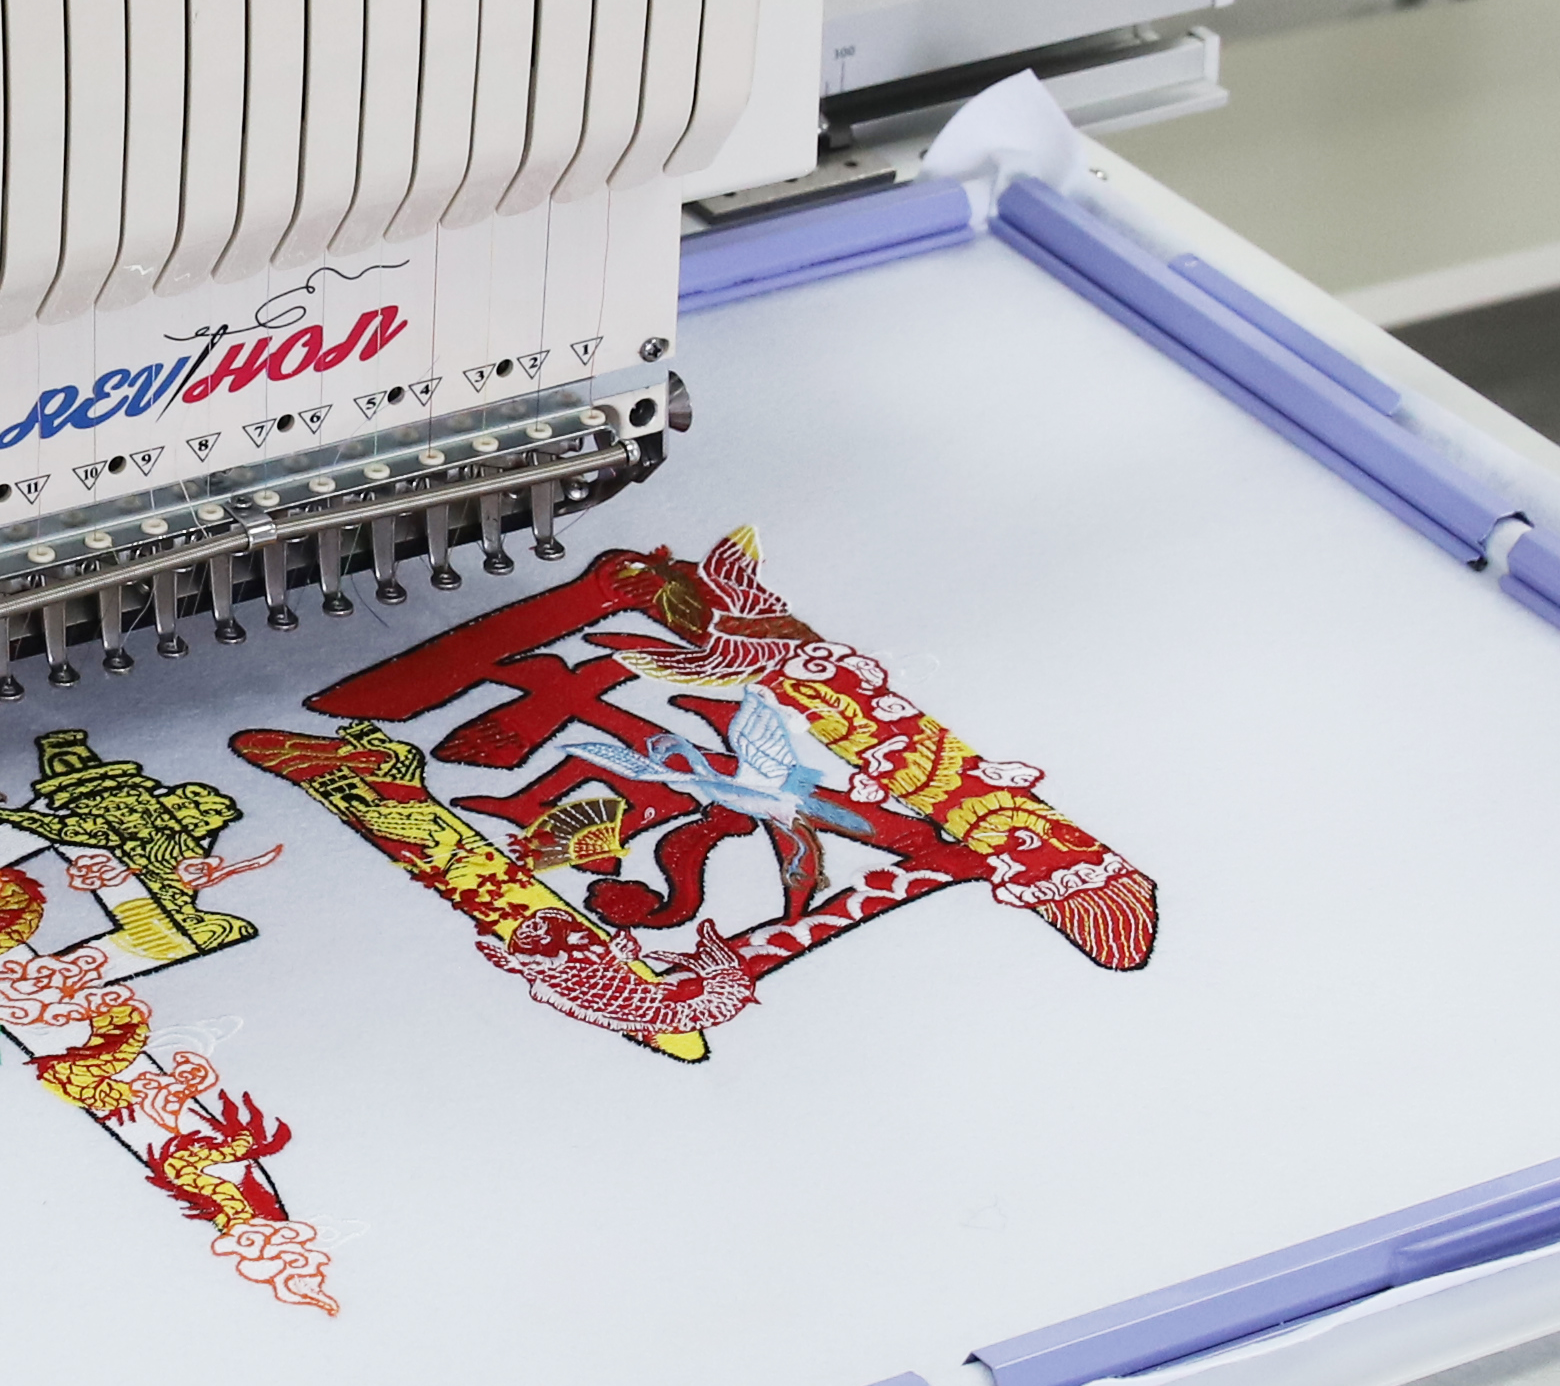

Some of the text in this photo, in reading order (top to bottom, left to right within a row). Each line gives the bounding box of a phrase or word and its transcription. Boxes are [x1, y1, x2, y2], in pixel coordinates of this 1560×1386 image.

[25, 481, 39, 495] 11
[82, 466, 99, 481] 10
[140, 453, 152, 467] 9
[197, 439, 209, 452] 8
[253, 425, 265, 438] 7
[309, 410, 321, 424] 6
[364, 397, 377, 410] 5
[419, 383, 430, 396] 4
[473, 370, 485, 383] 3
[528, 356, 539, 369] 2
[581, 344, 590, 356] 1
